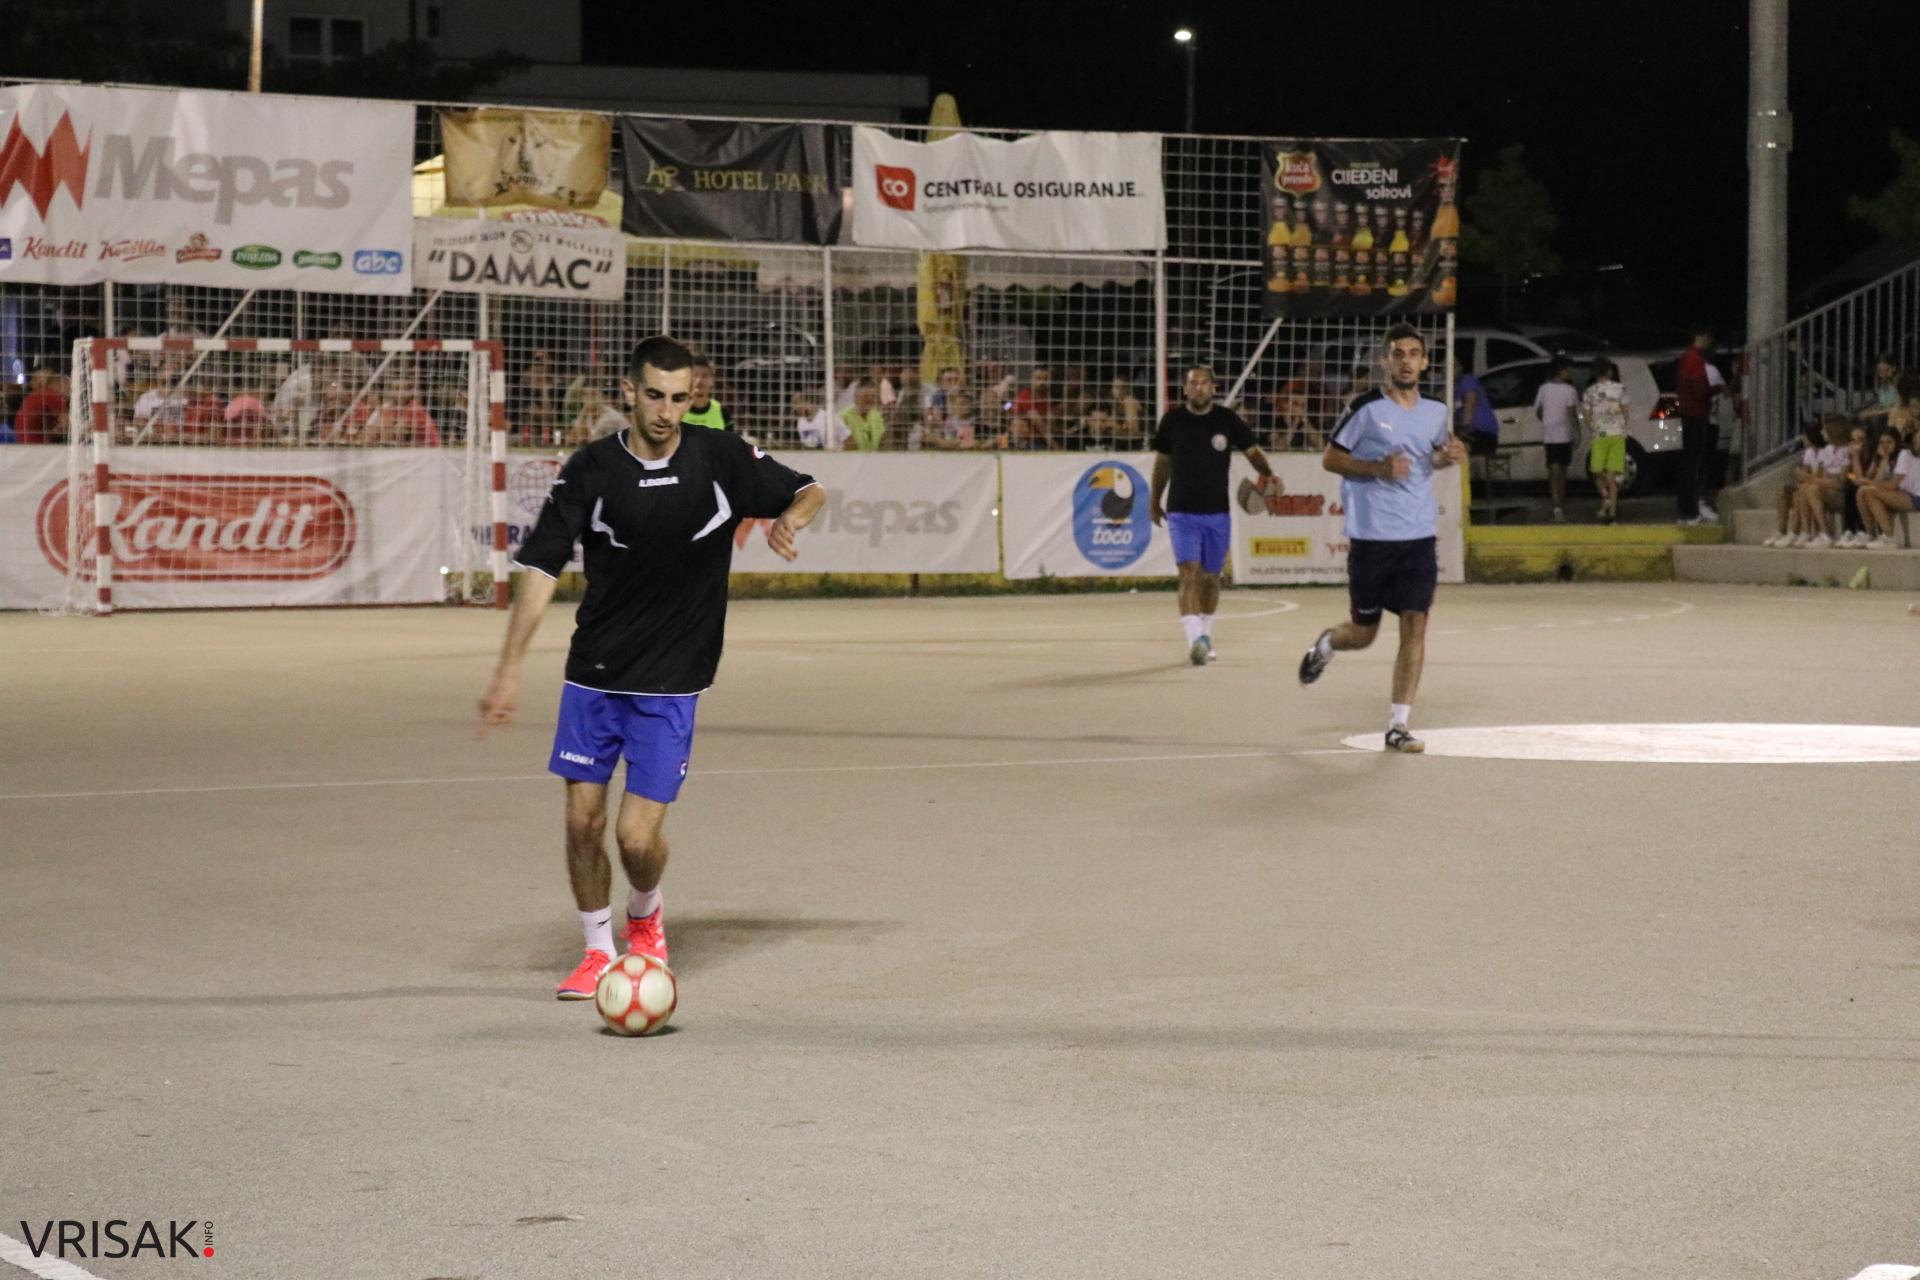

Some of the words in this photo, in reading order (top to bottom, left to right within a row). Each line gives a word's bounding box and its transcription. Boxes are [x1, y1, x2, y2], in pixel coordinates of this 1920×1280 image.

[95, 134, 354, 225] Mepas
[694, 169, 768, 191] HOTEL
[924, 179, 1008, 198] CENTRAL
[1014, 181, 1137, 198] OSIGURANJE
[1366, 184, 1412, 200] sokovi
[23, 236, 88, 260] Kandit
[355, 251, 399, 272] abc
[83, 493, 314, 563] Kandit
